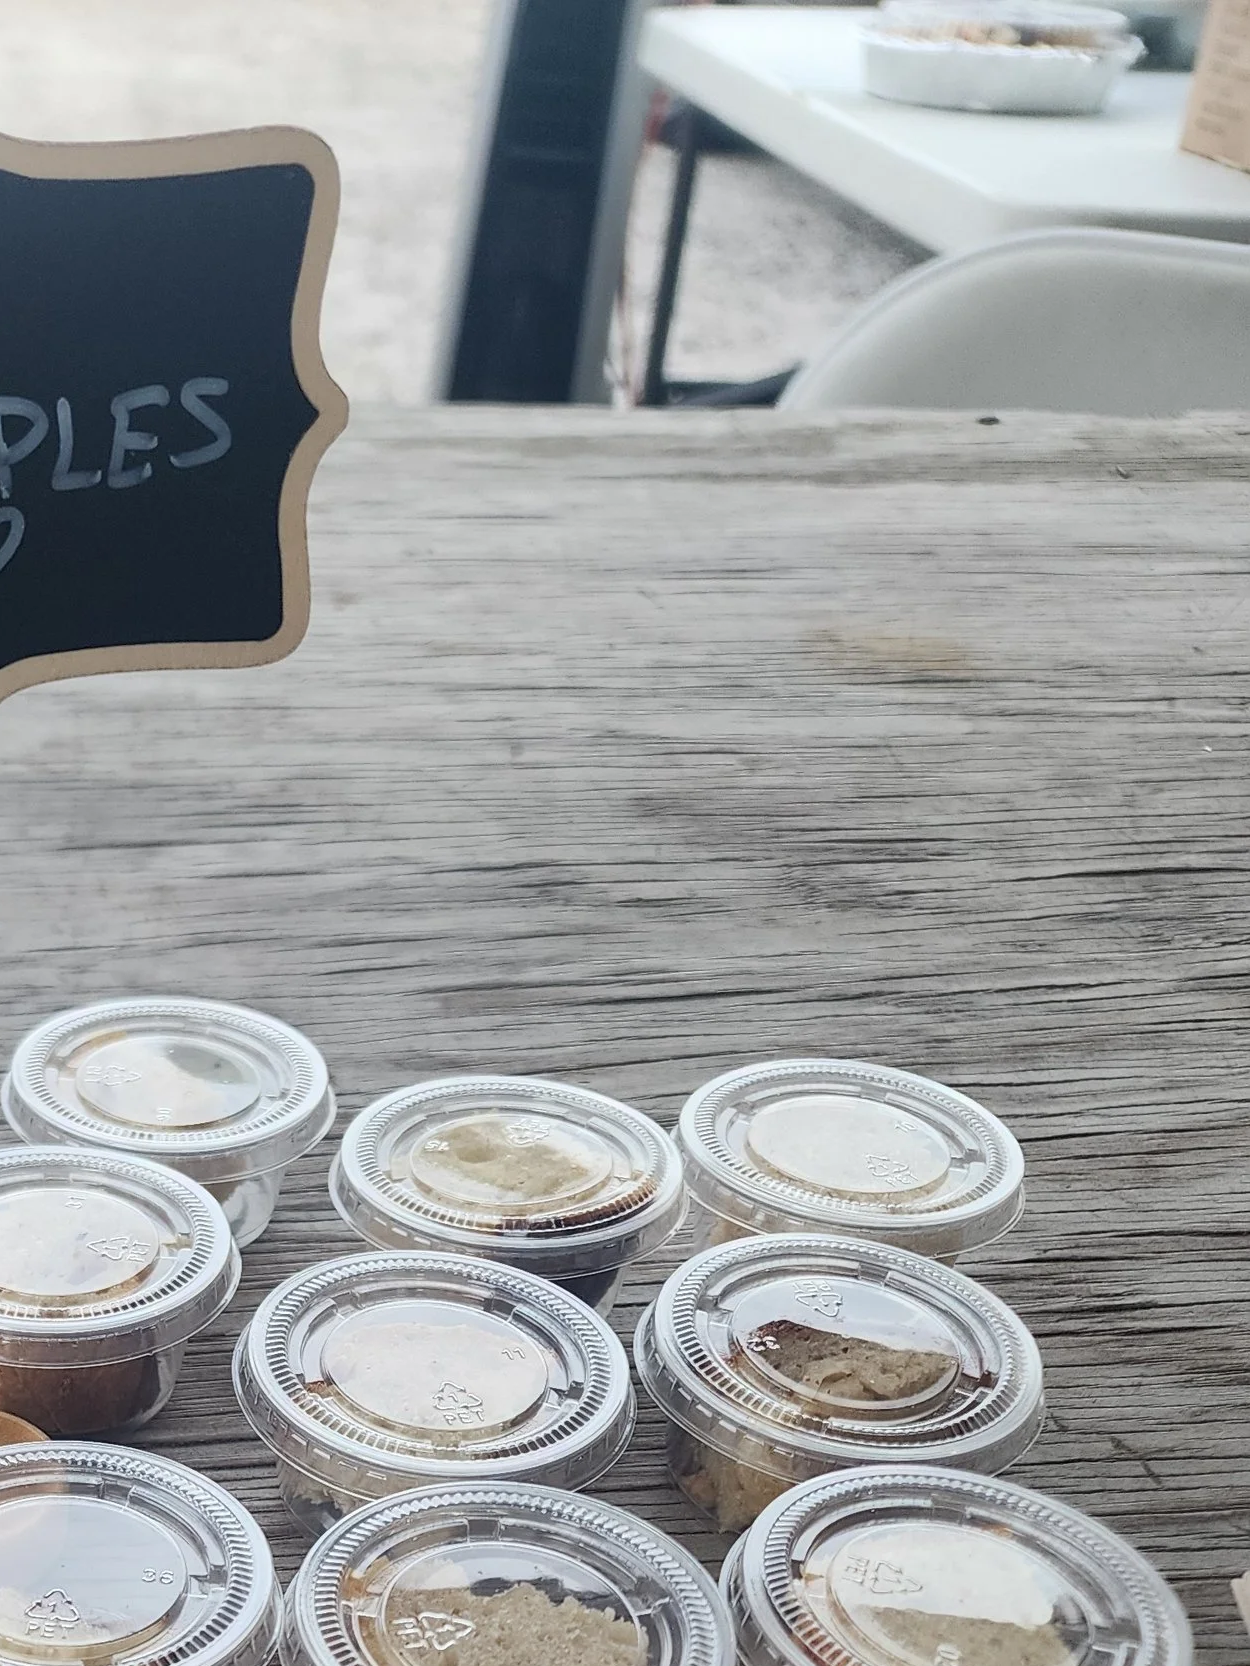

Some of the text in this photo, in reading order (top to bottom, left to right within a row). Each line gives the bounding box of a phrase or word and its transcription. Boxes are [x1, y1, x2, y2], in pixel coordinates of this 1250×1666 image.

[500, 1347, 526, 1360] 11
[443, 1408, 485, 1426] PET
[141, 1567, 175, 1585] 36
[24, 1620, 76, 1640] PET
[392, 1617, 430, 1650] PET
